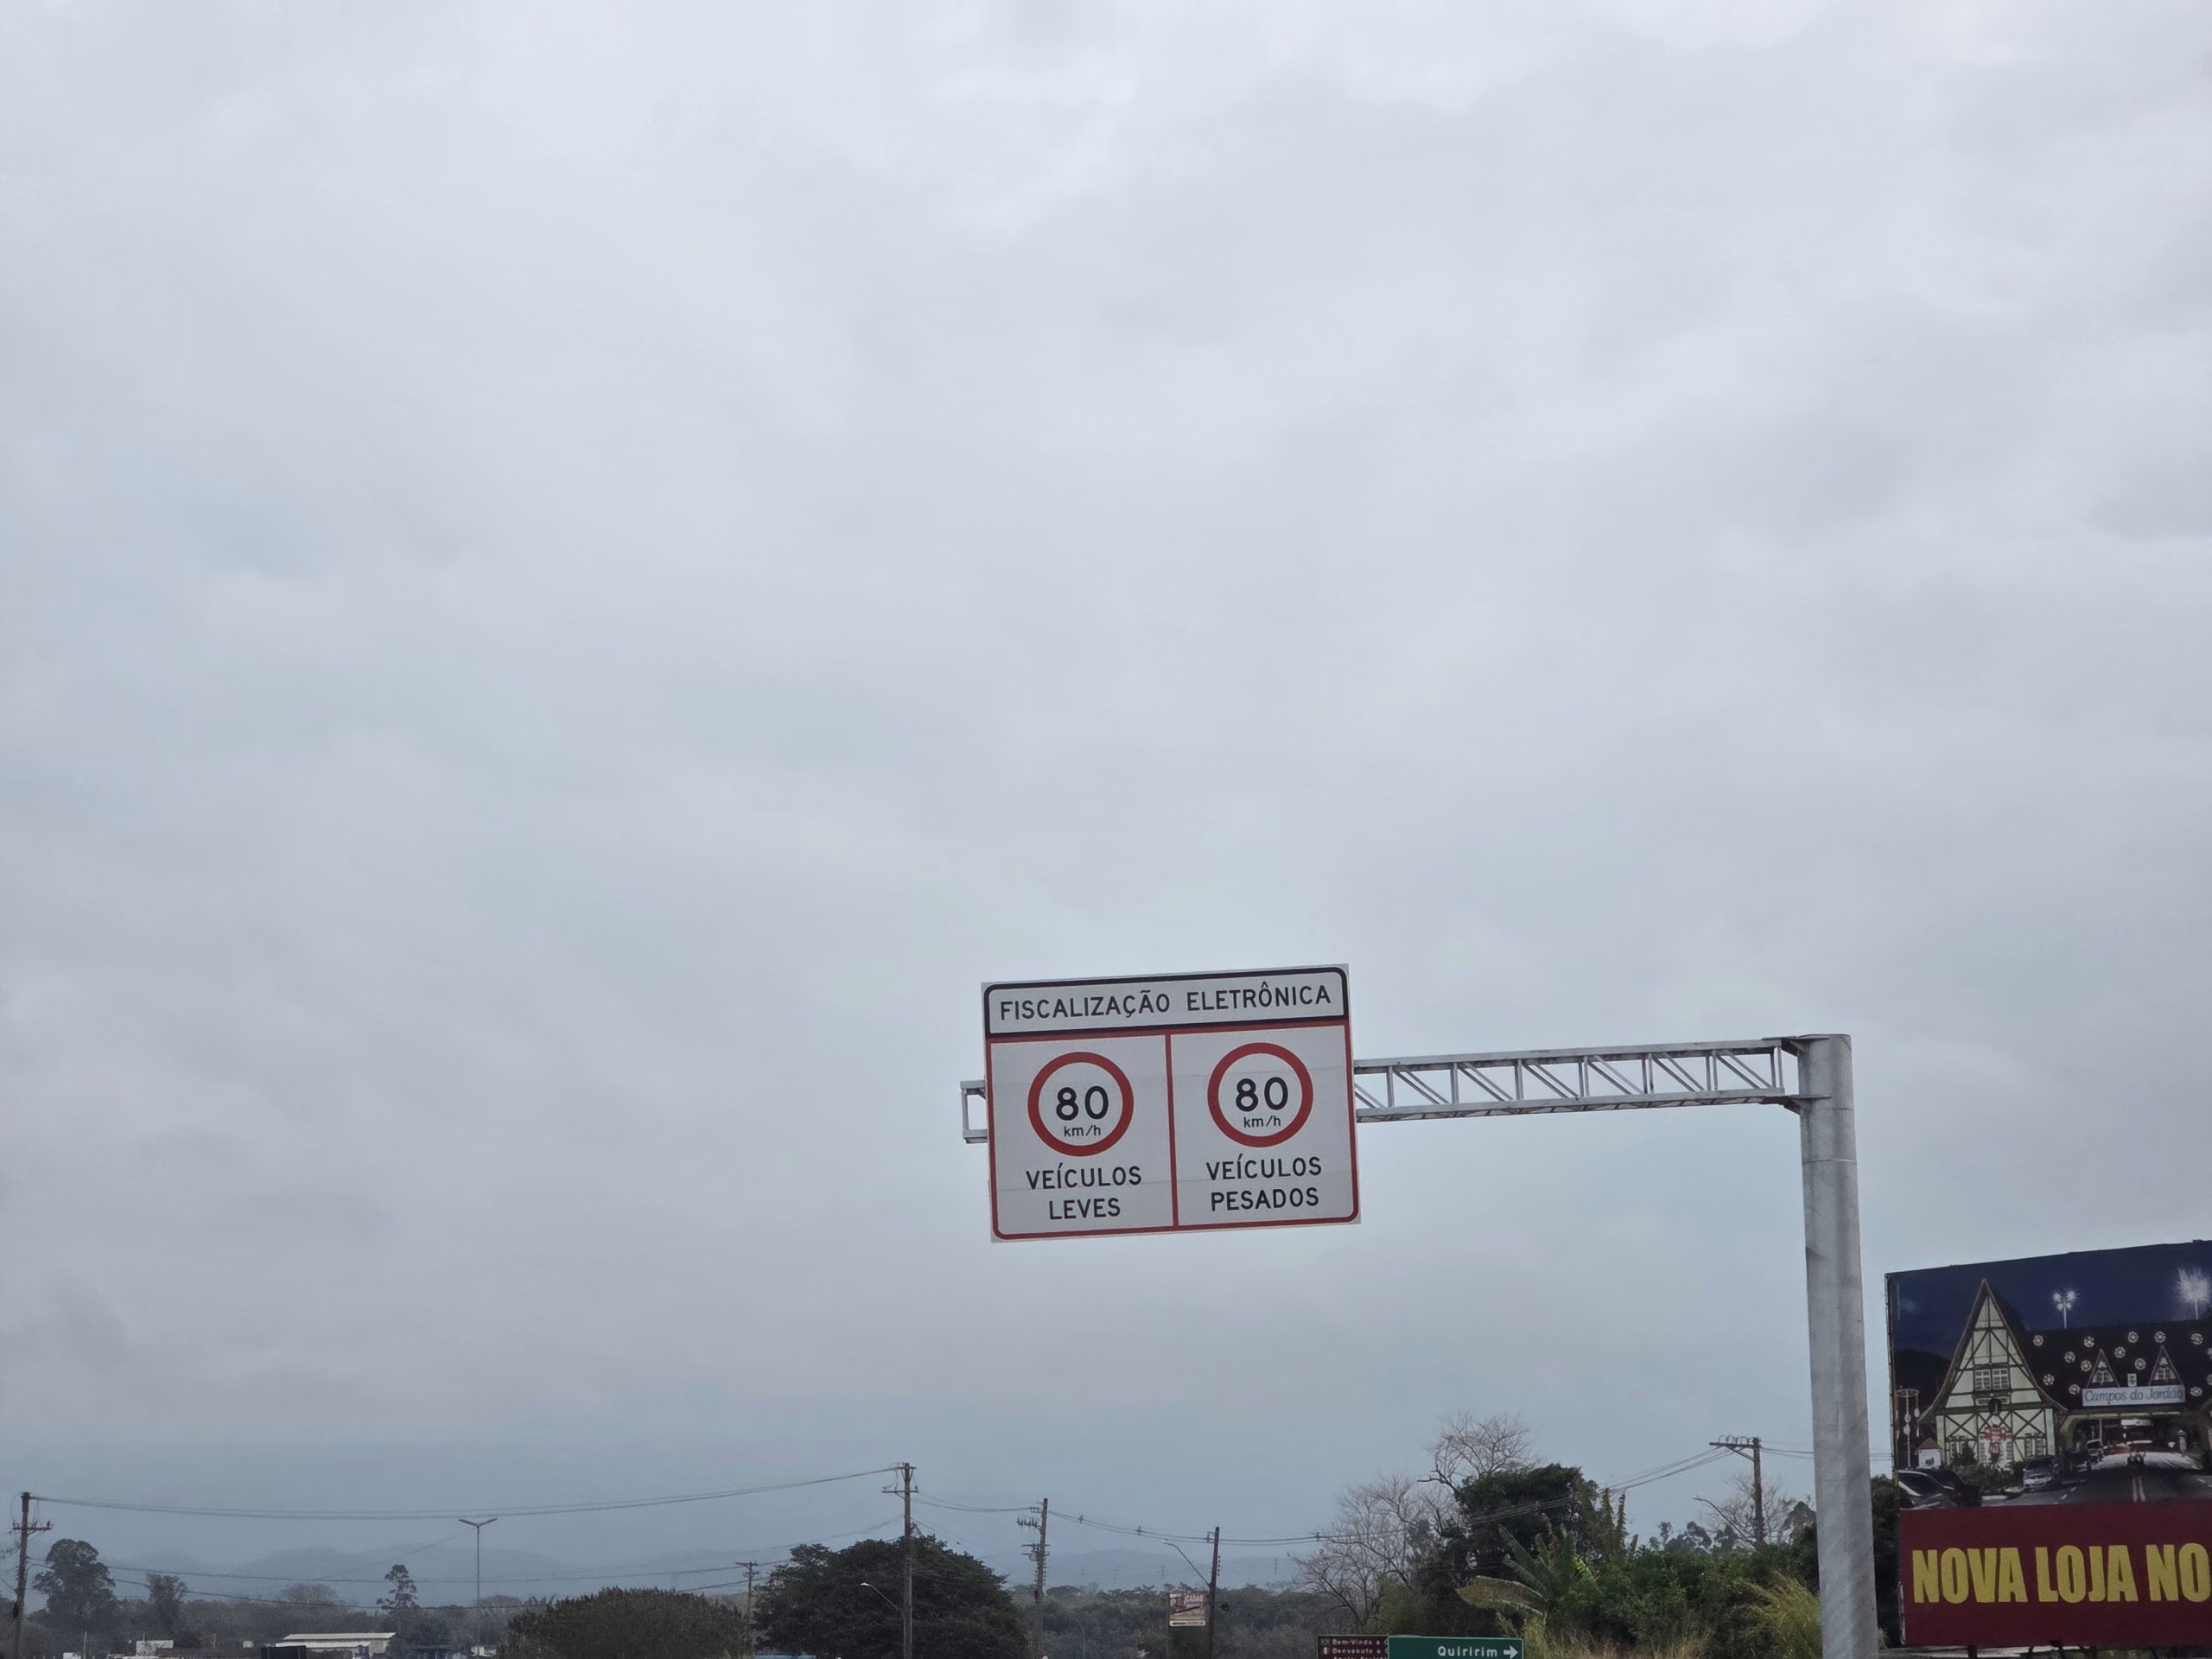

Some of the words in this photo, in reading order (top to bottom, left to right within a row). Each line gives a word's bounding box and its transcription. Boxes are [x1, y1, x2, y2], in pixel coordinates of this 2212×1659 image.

[1000, 990, 1170, 1020] FISCALIZAÇÃO
[1186, 982, 1332, 1012] ELETRÔNICA
[1056, 1086, 1109, 1121] 80
[1236, 1077, 1288, 1112] 80
[1064, 1124, 1102, 1138] km/h
[1243, 1115, 1281, 1128] km/h
[1026, 1163, 1142, 1190] VEÍCULOS
[1206, 1154, 1322, 1180] VEÍCULOS
[1048, 1197, 1121, 1220] LEVES
[1211, 1187, 1319, 1211] PESADOS
[2085, 1389, 2127, 1405] Campos
[2130, 1389, 2144, 1401] do
[2146, 1386, 2183, 1401] Jordão
[1913, 1548, 2028, 1604] NOVA
[2035, 1545, 2139, 1603] LOJA
[2145, 1542, 2212, 1603] NO
[1437, 1645, 1498, 1658] Quiririm
